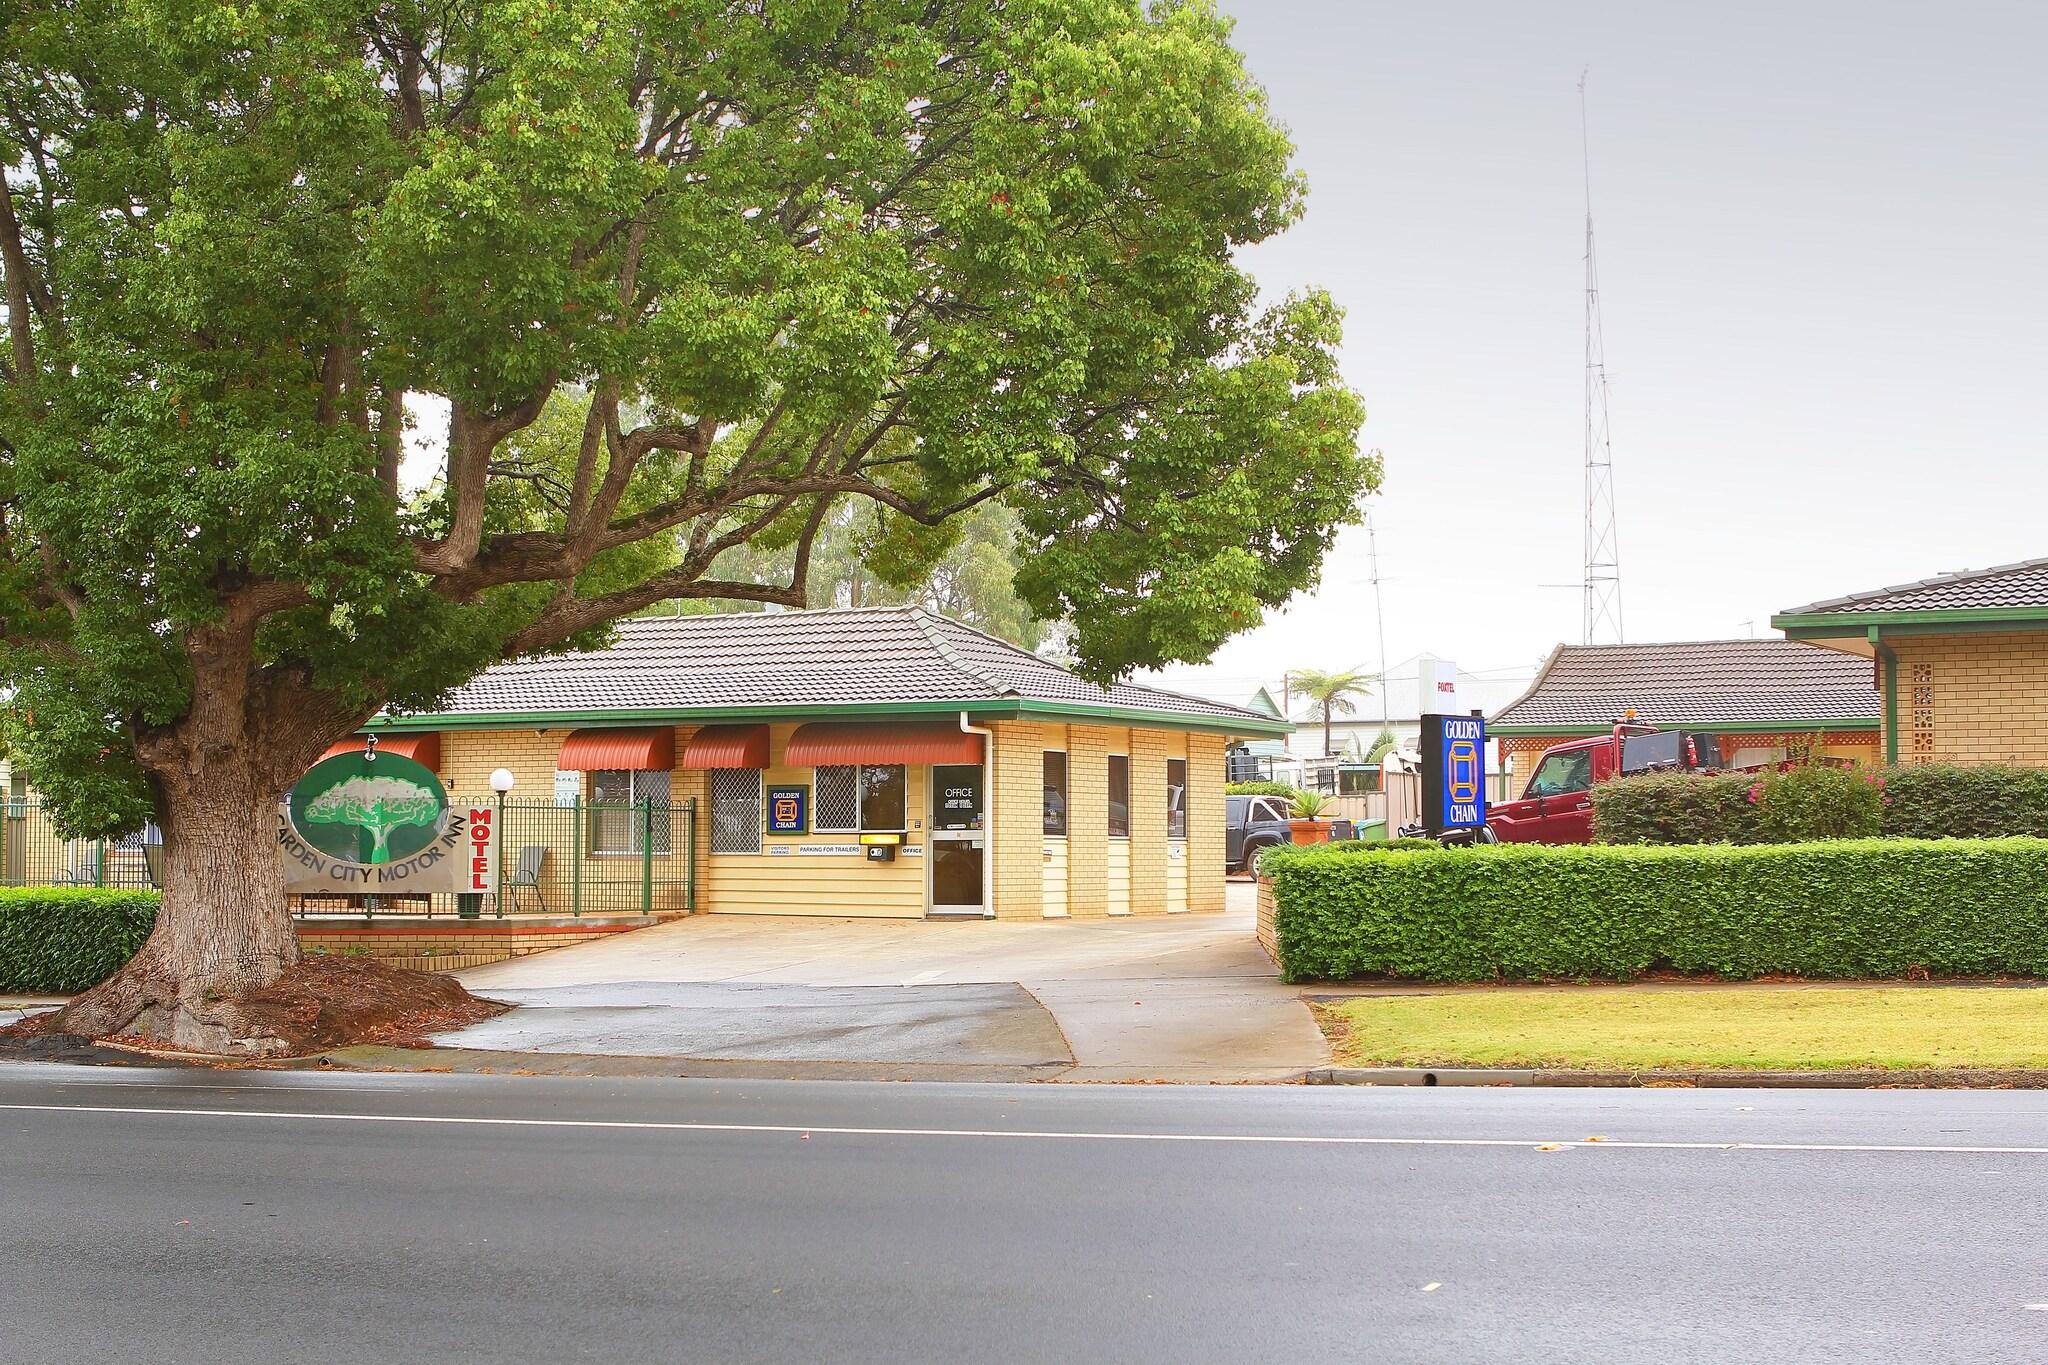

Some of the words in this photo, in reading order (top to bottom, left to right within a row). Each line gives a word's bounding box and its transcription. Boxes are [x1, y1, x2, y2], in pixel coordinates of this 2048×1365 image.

[1445, 720, 1480, 739] GOLDEN
[945, 787, 973, 798] OFFICE
[1450, 804, 1478, 823] CHAIN
[775, 821, 797, 829] CHAIN
[330, 864, 372, 883] CITY
[378, 846, 446, 883] MOTOR
[440, 815, 467, 849] INN
[469, 809, 492, 889] MOTEL
